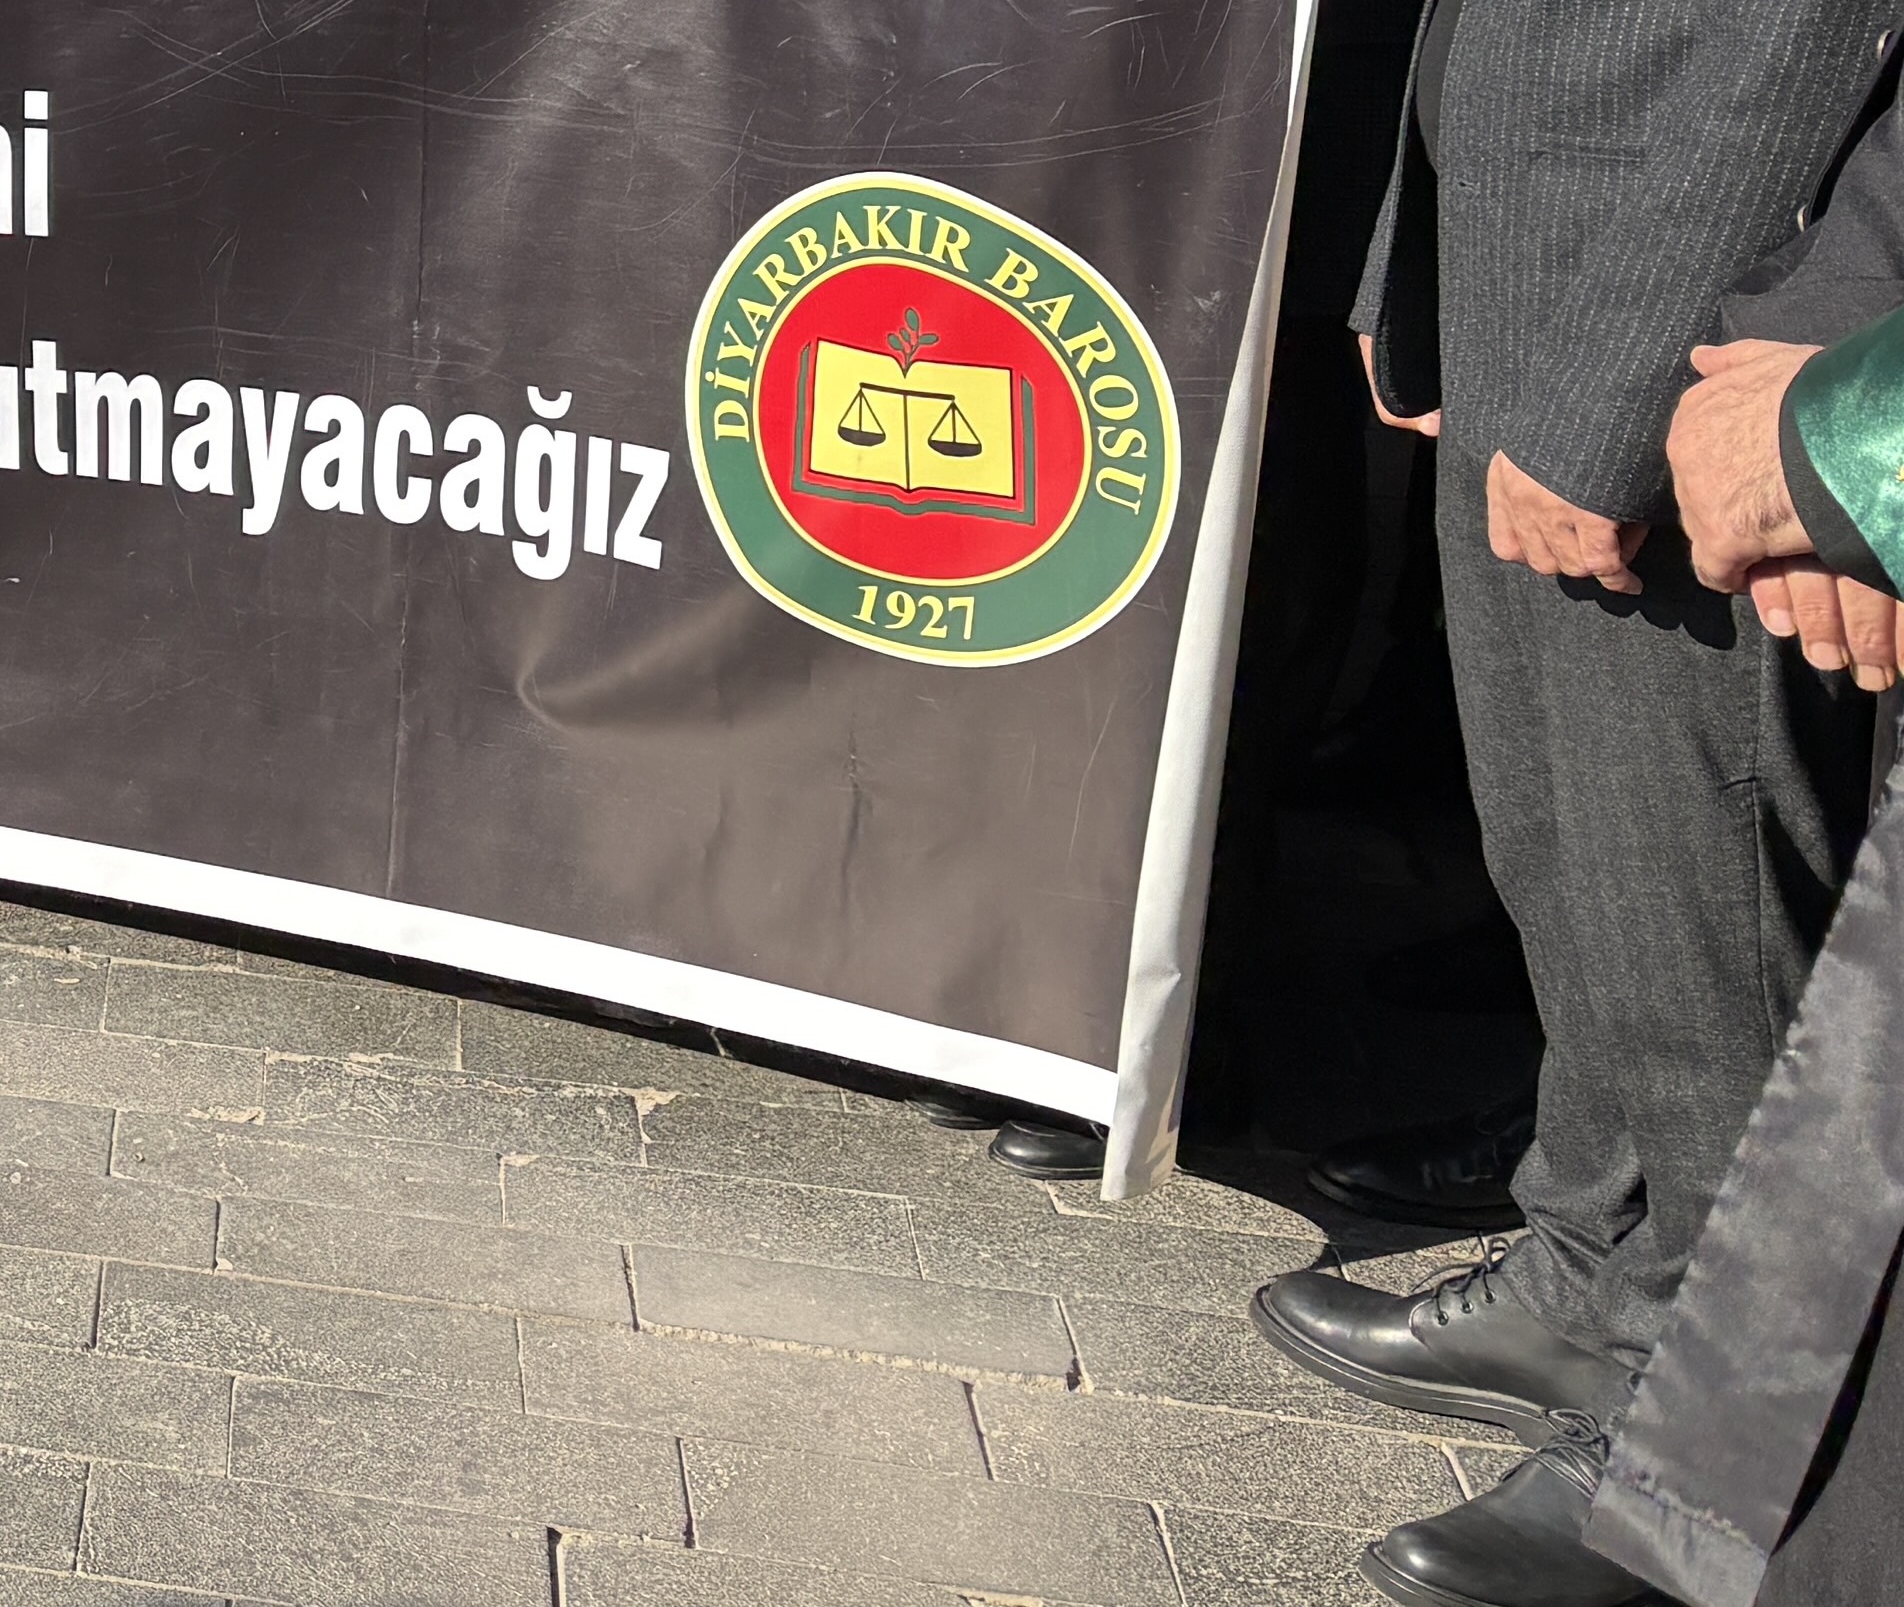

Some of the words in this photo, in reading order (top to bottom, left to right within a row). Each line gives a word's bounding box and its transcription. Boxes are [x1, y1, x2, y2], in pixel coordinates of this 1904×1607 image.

[705, 204, 973, 442] DİYARBAKIR
[984, 247, 1149, 515] BAROSU
[852, 585, 976, 641] 1927
